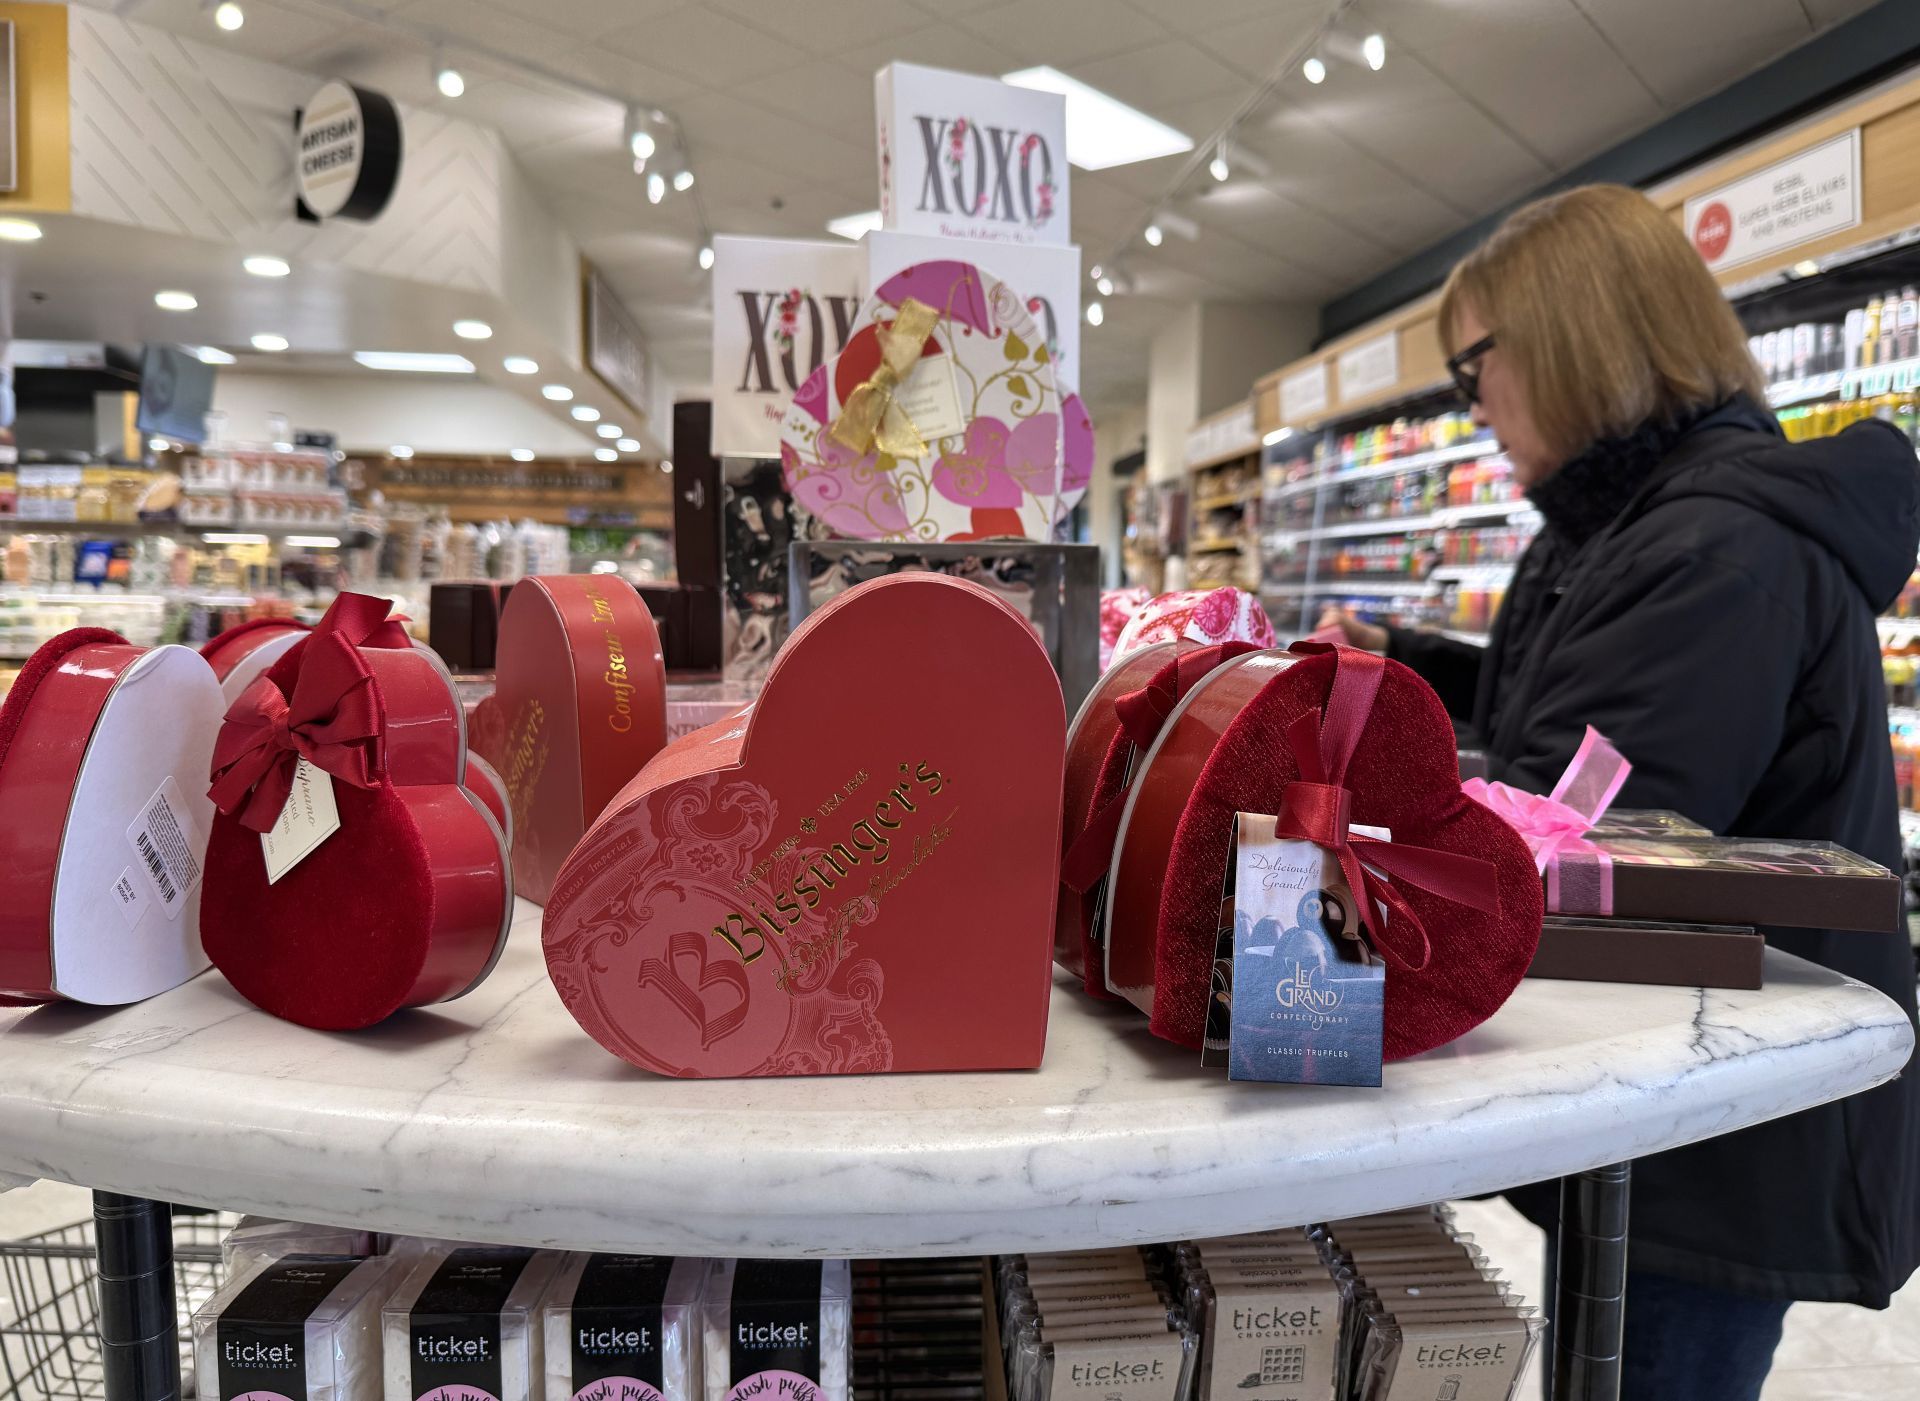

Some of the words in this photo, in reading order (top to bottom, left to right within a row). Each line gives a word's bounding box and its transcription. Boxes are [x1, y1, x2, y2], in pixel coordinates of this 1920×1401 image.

[302, 118, 357, 151] ARTISAN
[303, 142, 353, 176] CHEESE
[914, 116, 1056, 226] XOXO
[1777, 198, 1833, 230] PROTEINS
[604, 630, 636, 733] Confiseur
[588, 835, 634, 873] Imperial
[735, 860, 772, 894] PARIS
[817, 793, 846, 817] USA
[1248, 853, 1321, 878] Deliciously
[121, 876, 132, 893] BEST
[1262, 873, 1308, 892] Grand!
[1295, 961, 1311, 988] LE
[1275, 978, 1337, 1008] GRAND
[1270, 1011, 1350, 1026] CONFECTIONARY
[1267, 1046, 1302, 1056] CLASSIC
[1306, 1048, 1349, 1059] TRUFFLES
[1233, 1305, 1322, 1331] ticket
[579, 1326, 651, 1349] ticket
[738, 1321, 810, 1344] ticket
[225, 1340, 294, 1363] ticket
[418, 1335, 489, 1357] ticket
[1415, 1342, 1508, 1364] ticket
[1070, 1358, 1165, 1382] ticket
